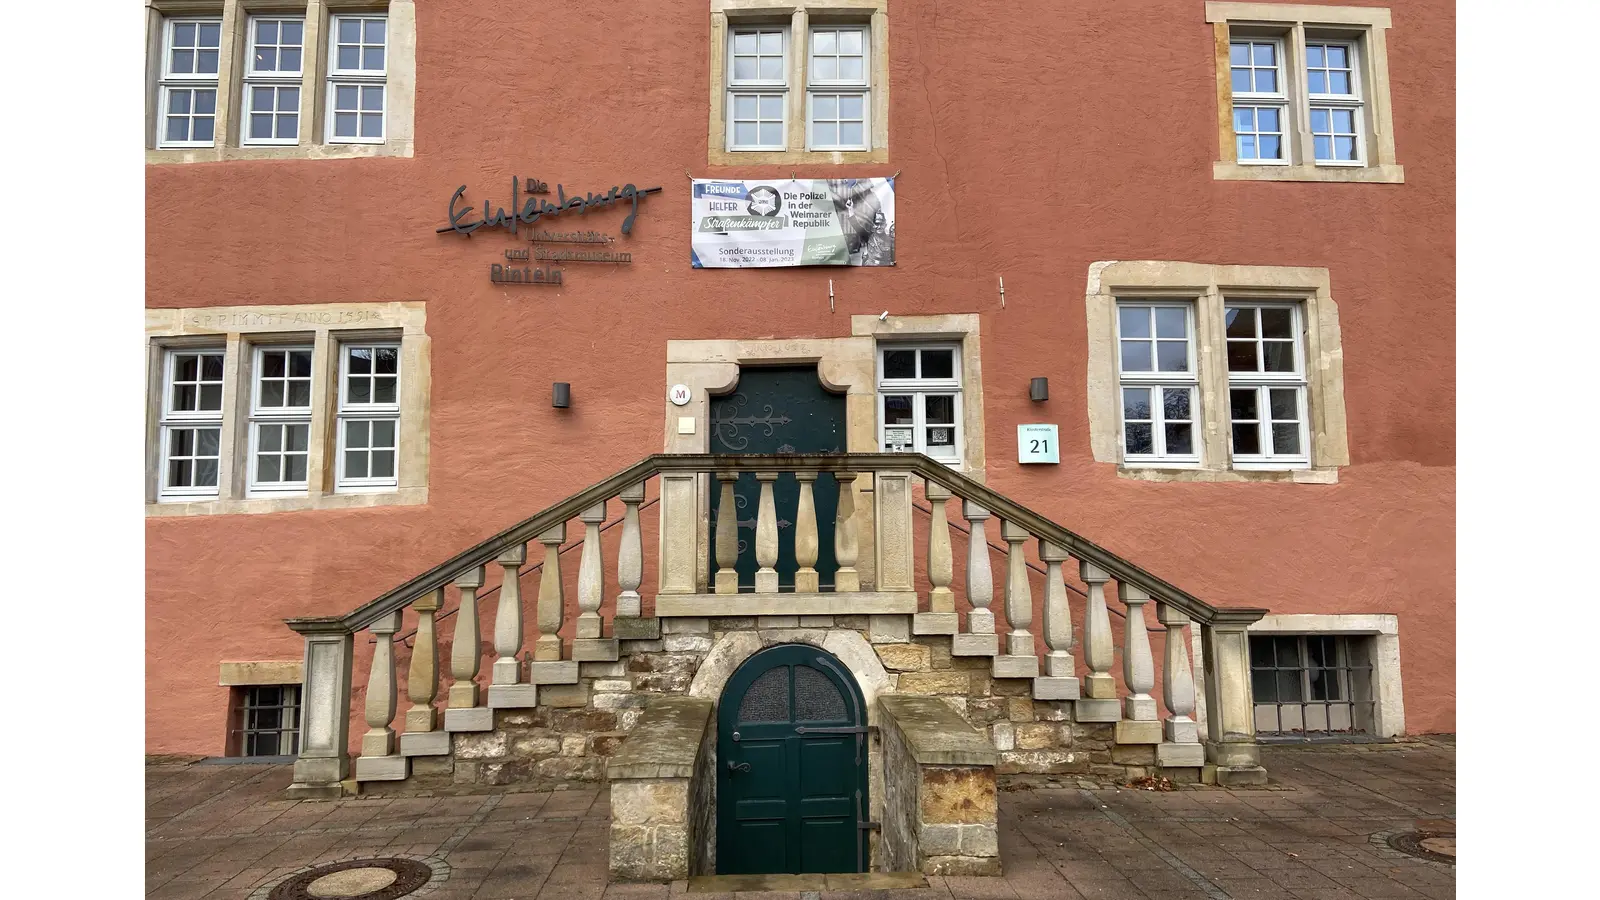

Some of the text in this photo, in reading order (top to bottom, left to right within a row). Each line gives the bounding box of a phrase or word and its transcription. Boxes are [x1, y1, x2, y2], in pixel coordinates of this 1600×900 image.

[526, 178, 549, 193] Die
[705, 184, 741, 194] FREUNDE
[783, 191, 827, 200] Die Polizei
[709, 201, 738, 211] HELFER
[788, 201, 813, 210] in der
[790, 210, 832, 219] Weimarer
[703, 217, 780, 232] Straßenkämpfer
[792, 219, 831, 229] Republik
[505, 249, 530, 260] und
[719, 247, 795, 256] Sonderausstellung
[490, 263, 562, 283] Rinteln
[293, 311, 333, 324] ANNO
[676, 389, 686, 399] M
[1030, 439, 1048, 454] 21
